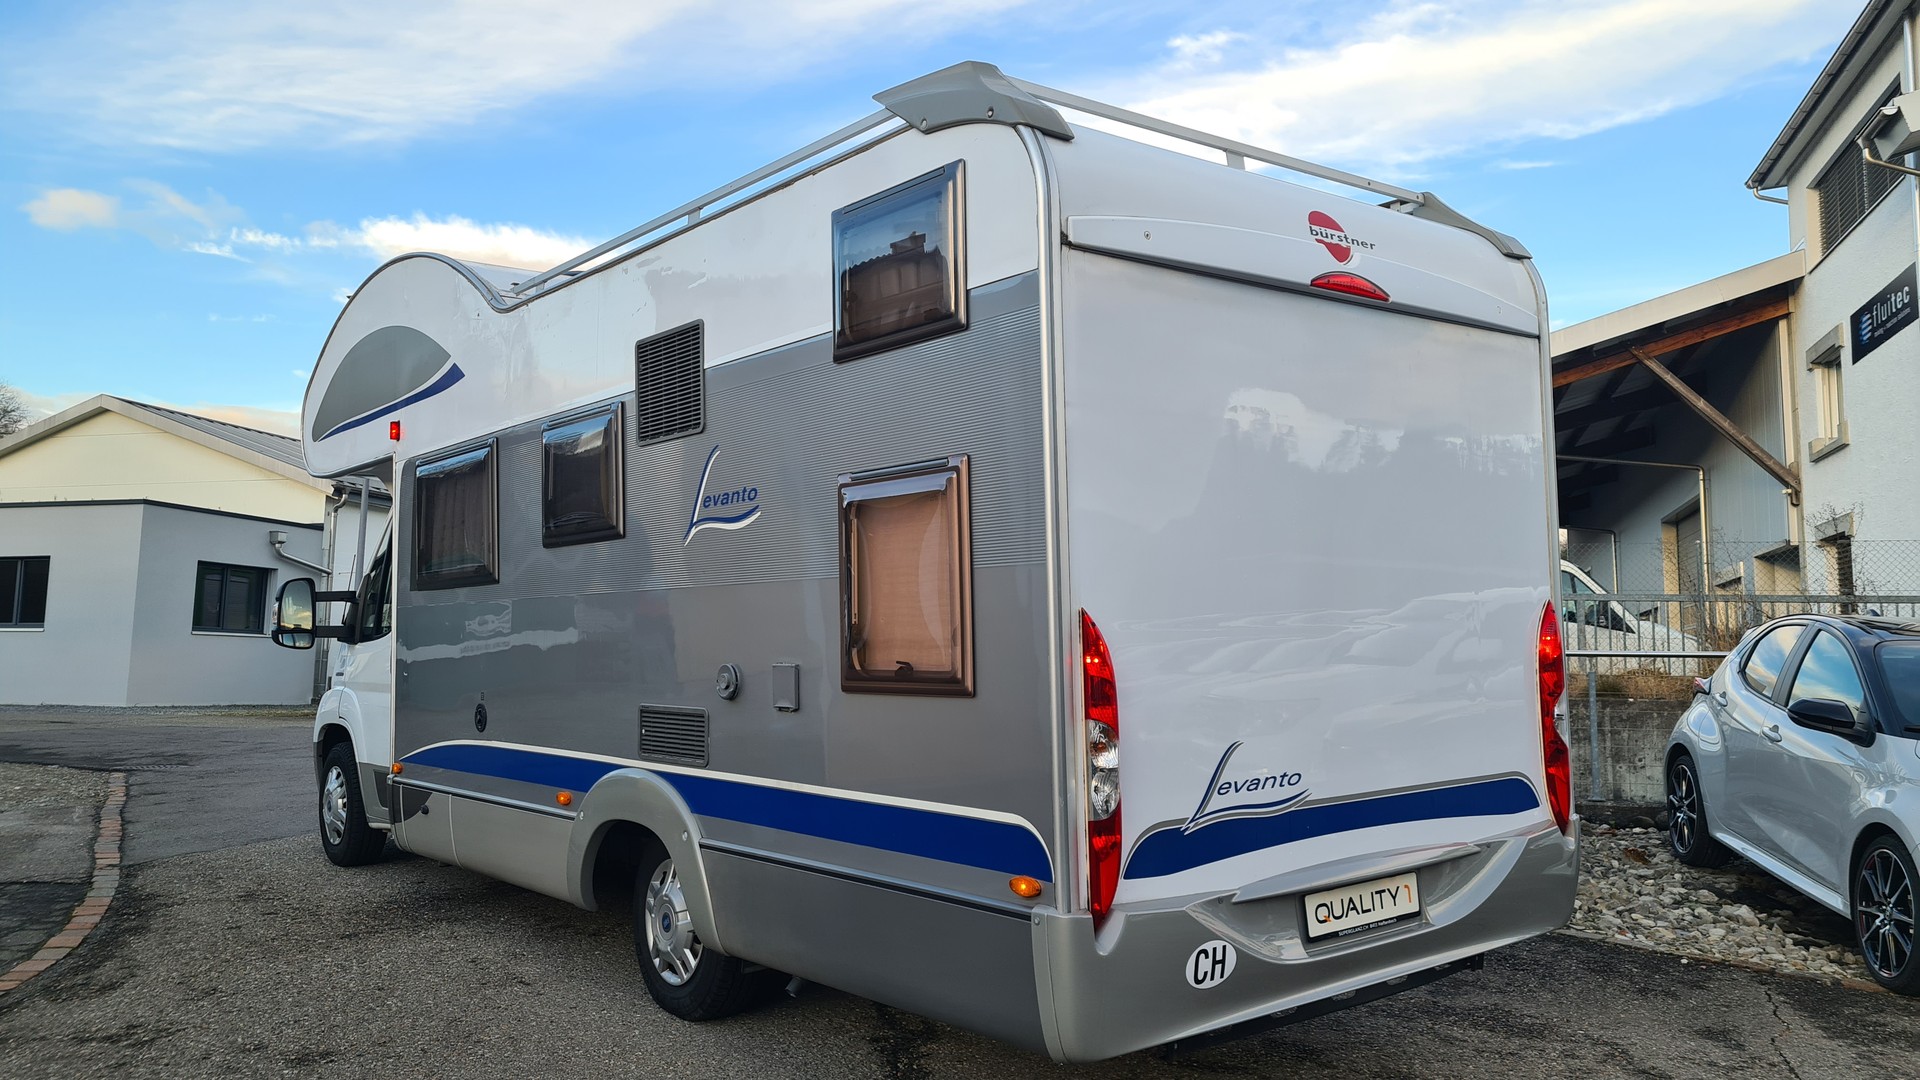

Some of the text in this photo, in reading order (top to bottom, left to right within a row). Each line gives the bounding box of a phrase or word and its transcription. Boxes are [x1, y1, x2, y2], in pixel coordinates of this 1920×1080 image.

[1309, 225, 1376, 250] bürstner
[1872, 286, 1911, 327] fluitec
[683, 444, 761, 547] Levanto
[1180, 740, 1311, 835] Levanto
[1314, 884, 1412, 924] QUALITY 1
[1194, 944, 1227, 985] CH
